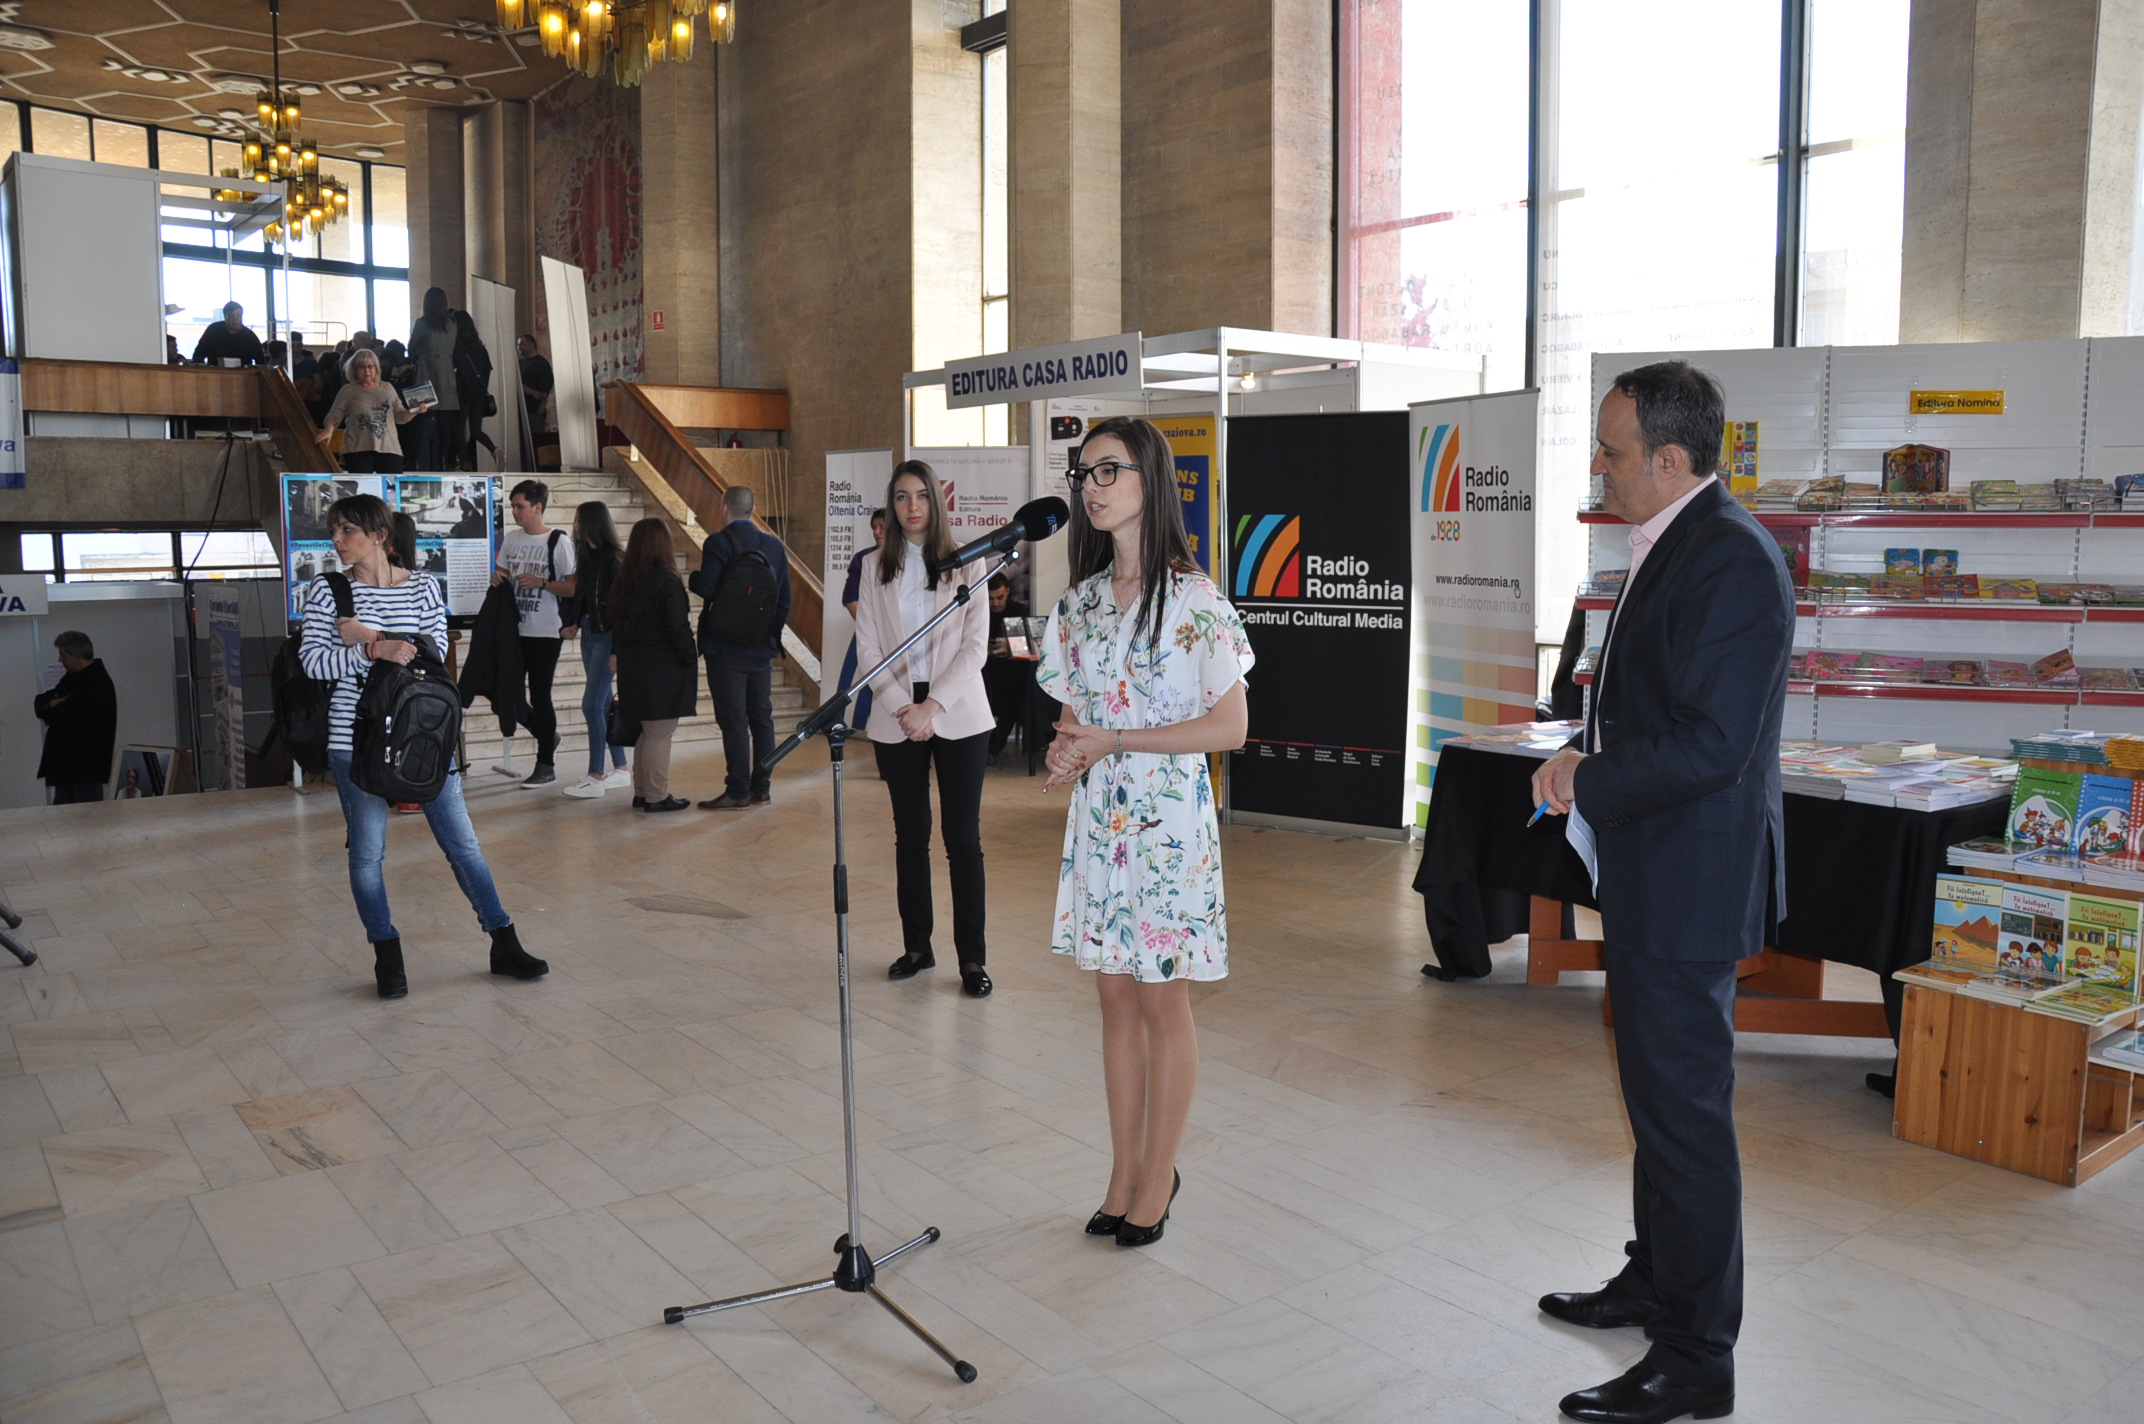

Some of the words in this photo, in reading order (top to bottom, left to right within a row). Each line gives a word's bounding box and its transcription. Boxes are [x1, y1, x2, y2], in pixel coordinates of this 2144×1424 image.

[952, 365, 1019, 396] EDITURA
[1022, 359, 1068, 387] CASA
[1072, 349, 1129, 381] RADIO
[1917, 398, 1955, 408] Editura
[1957, 398, 2000, 408] Nomina
[829, 481, 851, 492] Radio
[1465, 466, 1510, 487] Radio
[829, 492, 862, 504] România
[979, 494, 1009, 502] România
[1465, 490, 1532, 512] România
[828, 504, 855, 517] Oltenia
[857, 505, 879, 516] Craio
[967, 514, 1009, 527] Radio
[1436, 520, 1461, 542] 1928
[1306, 555, 1370, 576] Radio
[1306, 578, 1404, 600] România
[1435, 573, 1520, 589] www.radioromania.ro
[1423, 593, 1532, 615] www.radioromania.ro
[1236, 609, 1290, 626] Centrul
[1292, 610, 1351, 627] Cultural
[1354, 612, 1403, 629] Media
